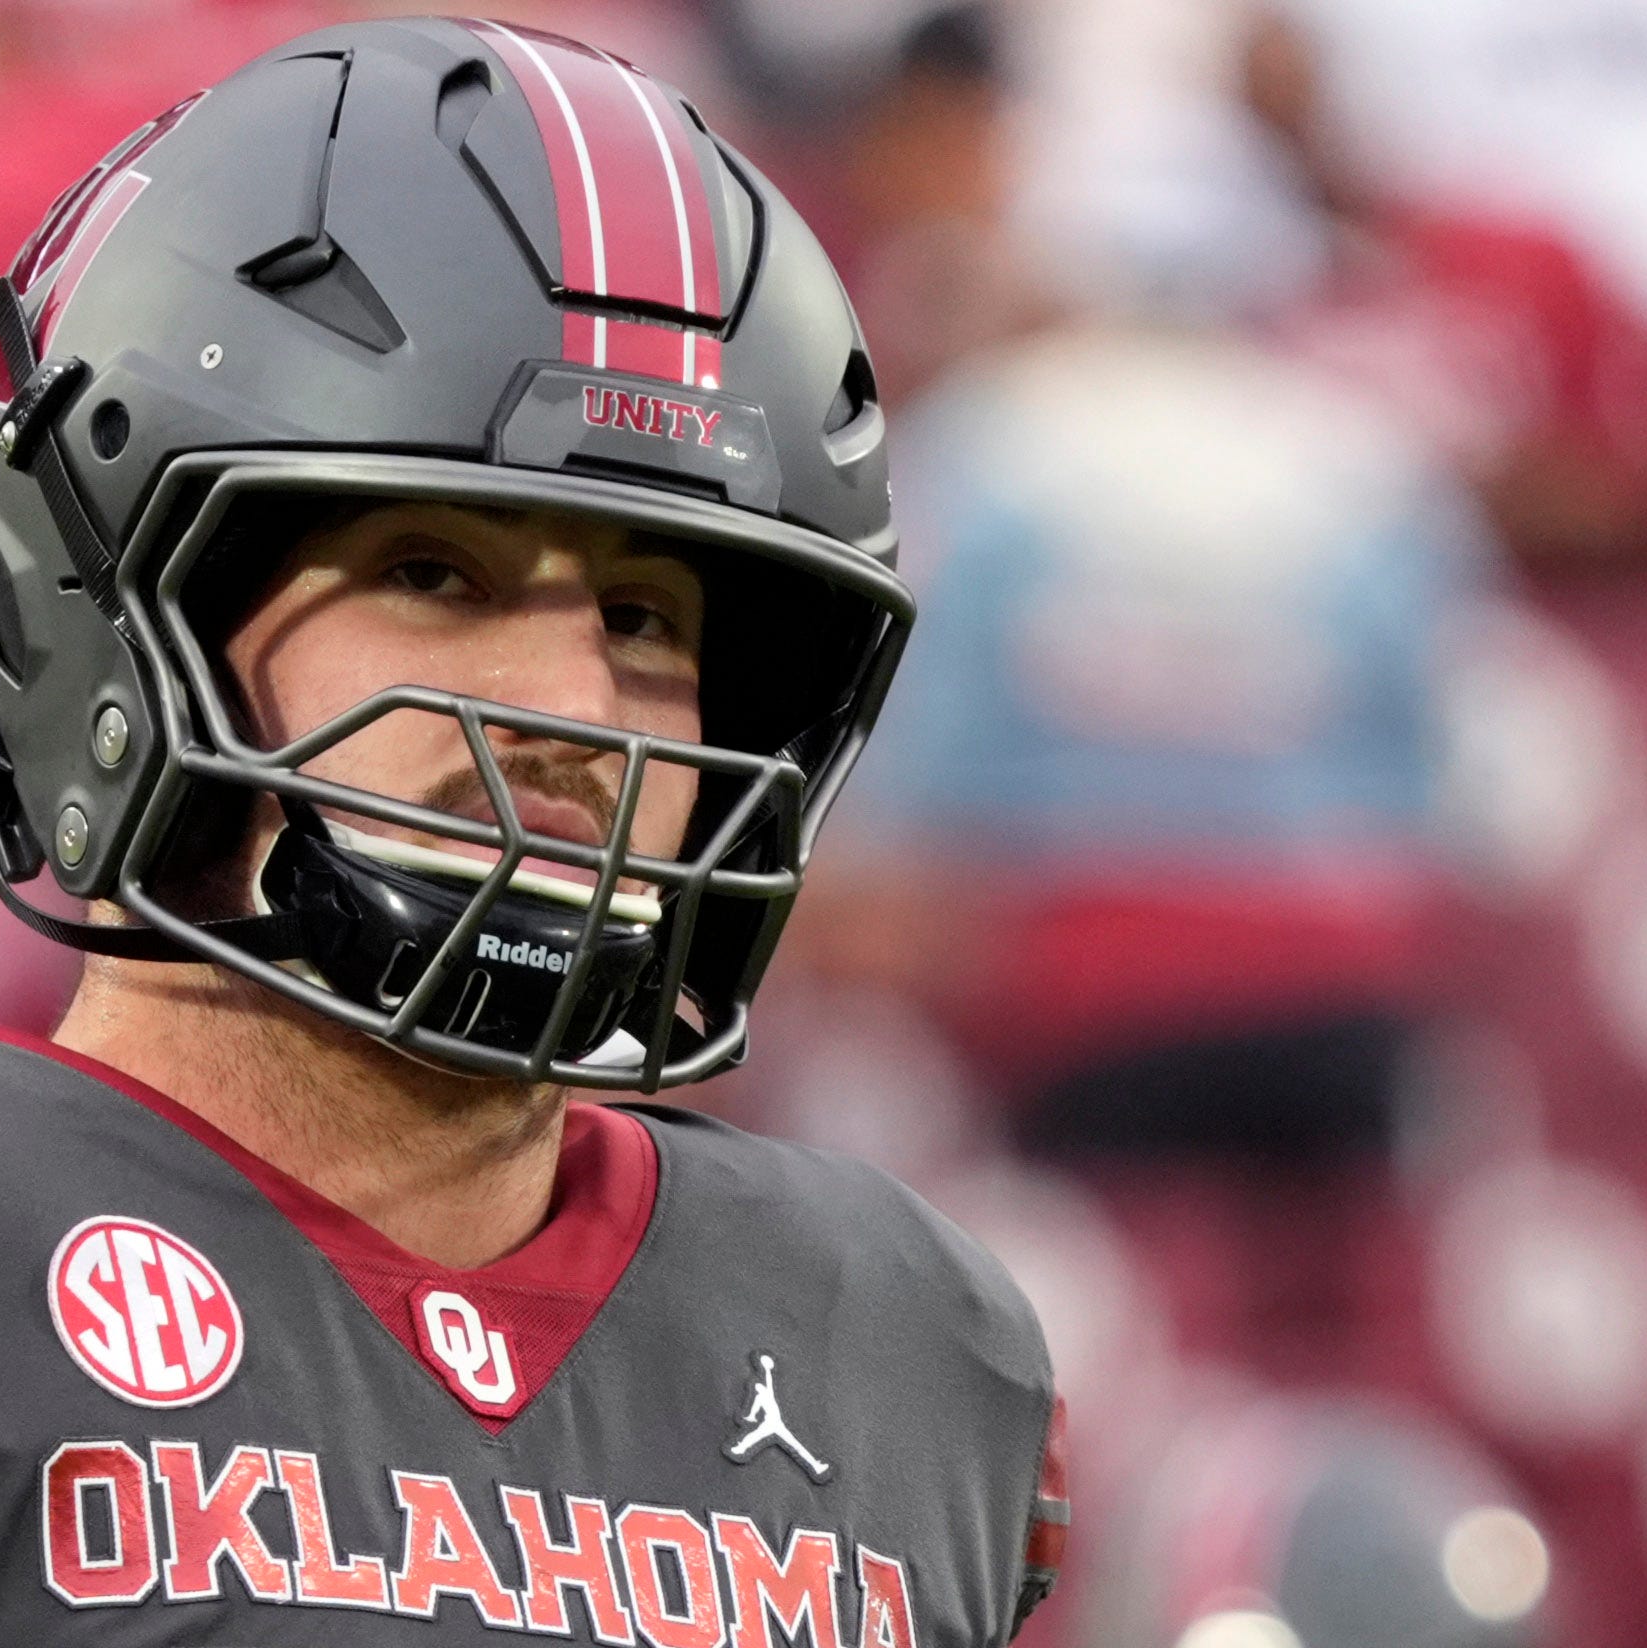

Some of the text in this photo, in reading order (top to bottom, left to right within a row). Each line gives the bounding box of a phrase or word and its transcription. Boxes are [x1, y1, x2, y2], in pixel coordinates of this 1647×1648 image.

[582, 386, 723, 447] UNITY
[476, 933, 574, 975] Riddel
[64, 1229, 228, 1393] SEC
[422, 1290, 516, 1404] OU
